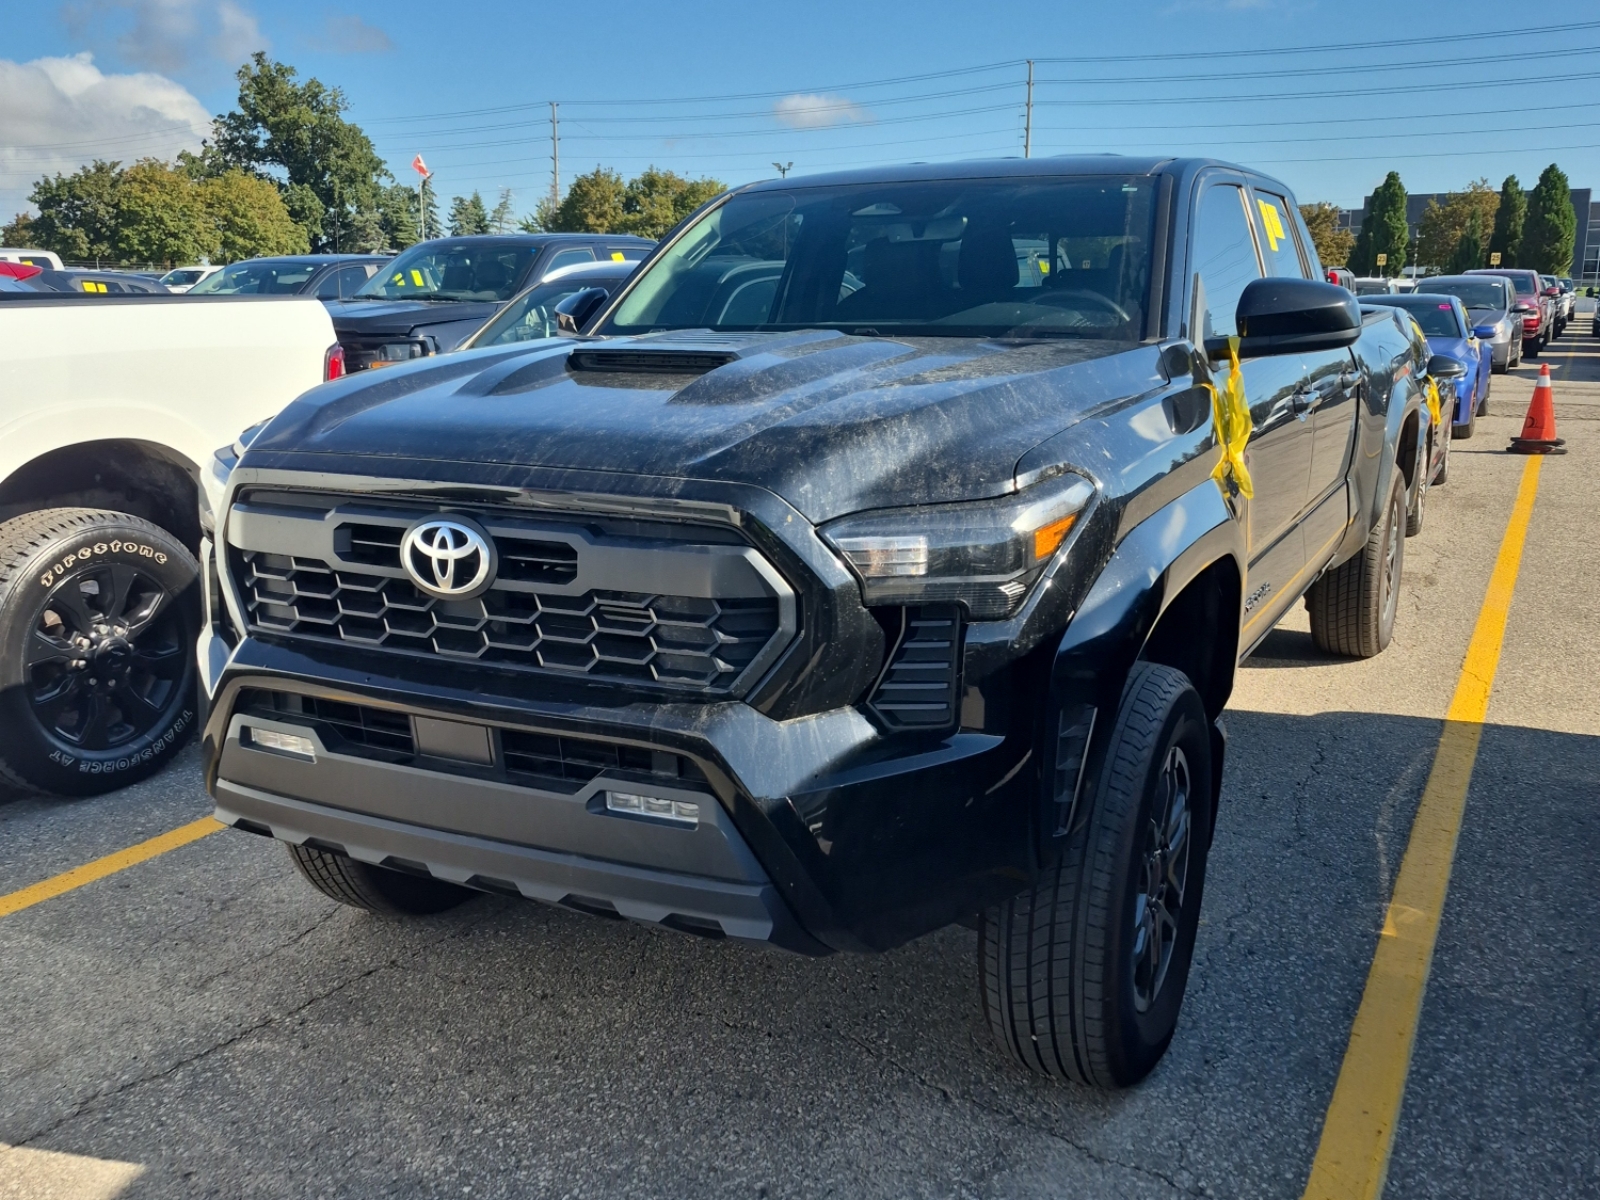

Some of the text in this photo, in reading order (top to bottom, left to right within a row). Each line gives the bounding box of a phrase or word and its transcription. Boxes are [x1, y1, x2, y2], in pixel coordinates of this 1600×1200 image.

[40, 539, 168, 588] Firestone
[49, 709, 194, 774] TRANSFORCE AT
